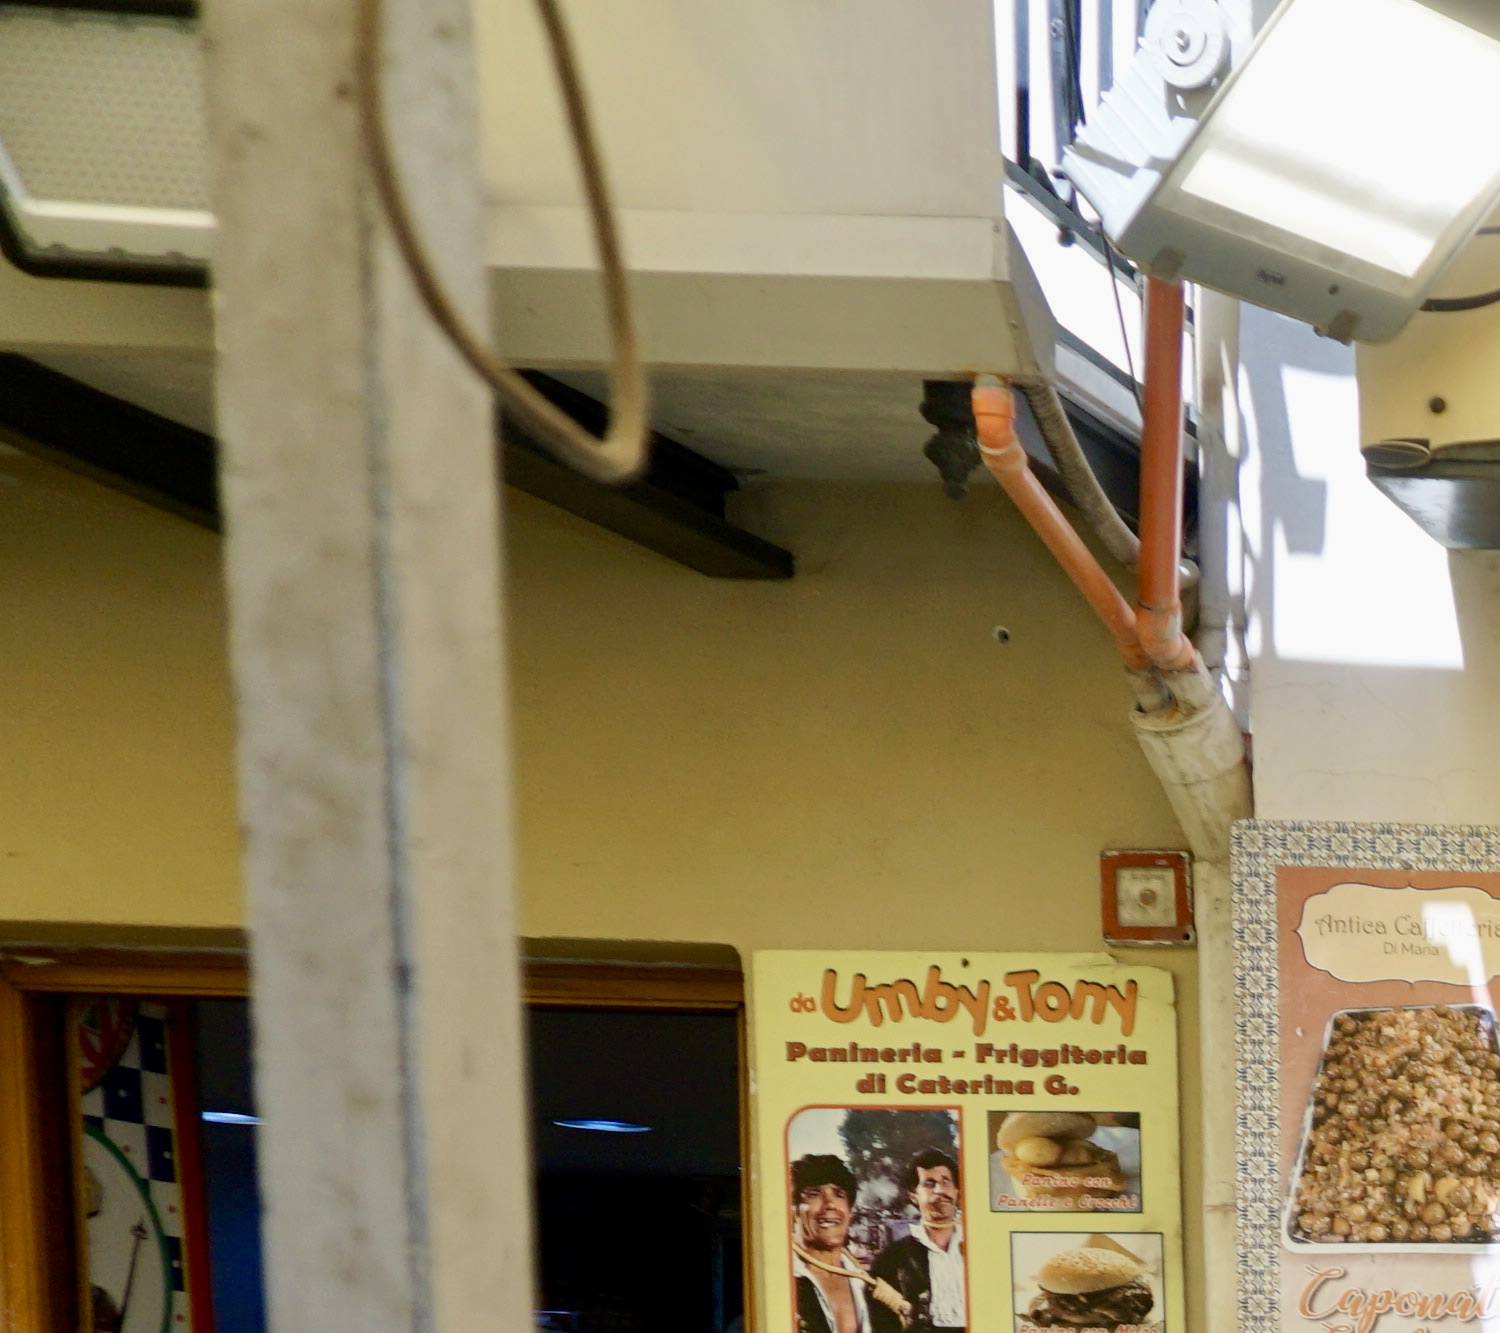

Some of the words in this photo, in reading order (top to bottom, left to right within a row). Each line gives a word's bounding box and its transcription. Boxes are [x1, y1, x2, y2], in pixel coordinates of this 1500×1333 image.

[1314, 914, 1388, 937] Antica
[1383, 941, 1398, 955] Di
[789, 992, 817, 1014] da
[785, 1041, 943, 1064] Panineria
[975, 1043, 1148, 1069] Friggitoria
[856, 1073, 886, 1094] di
[896, 1074, 1035, 1096] Caterina
[1044, 1075, 1081, 1096] G.
